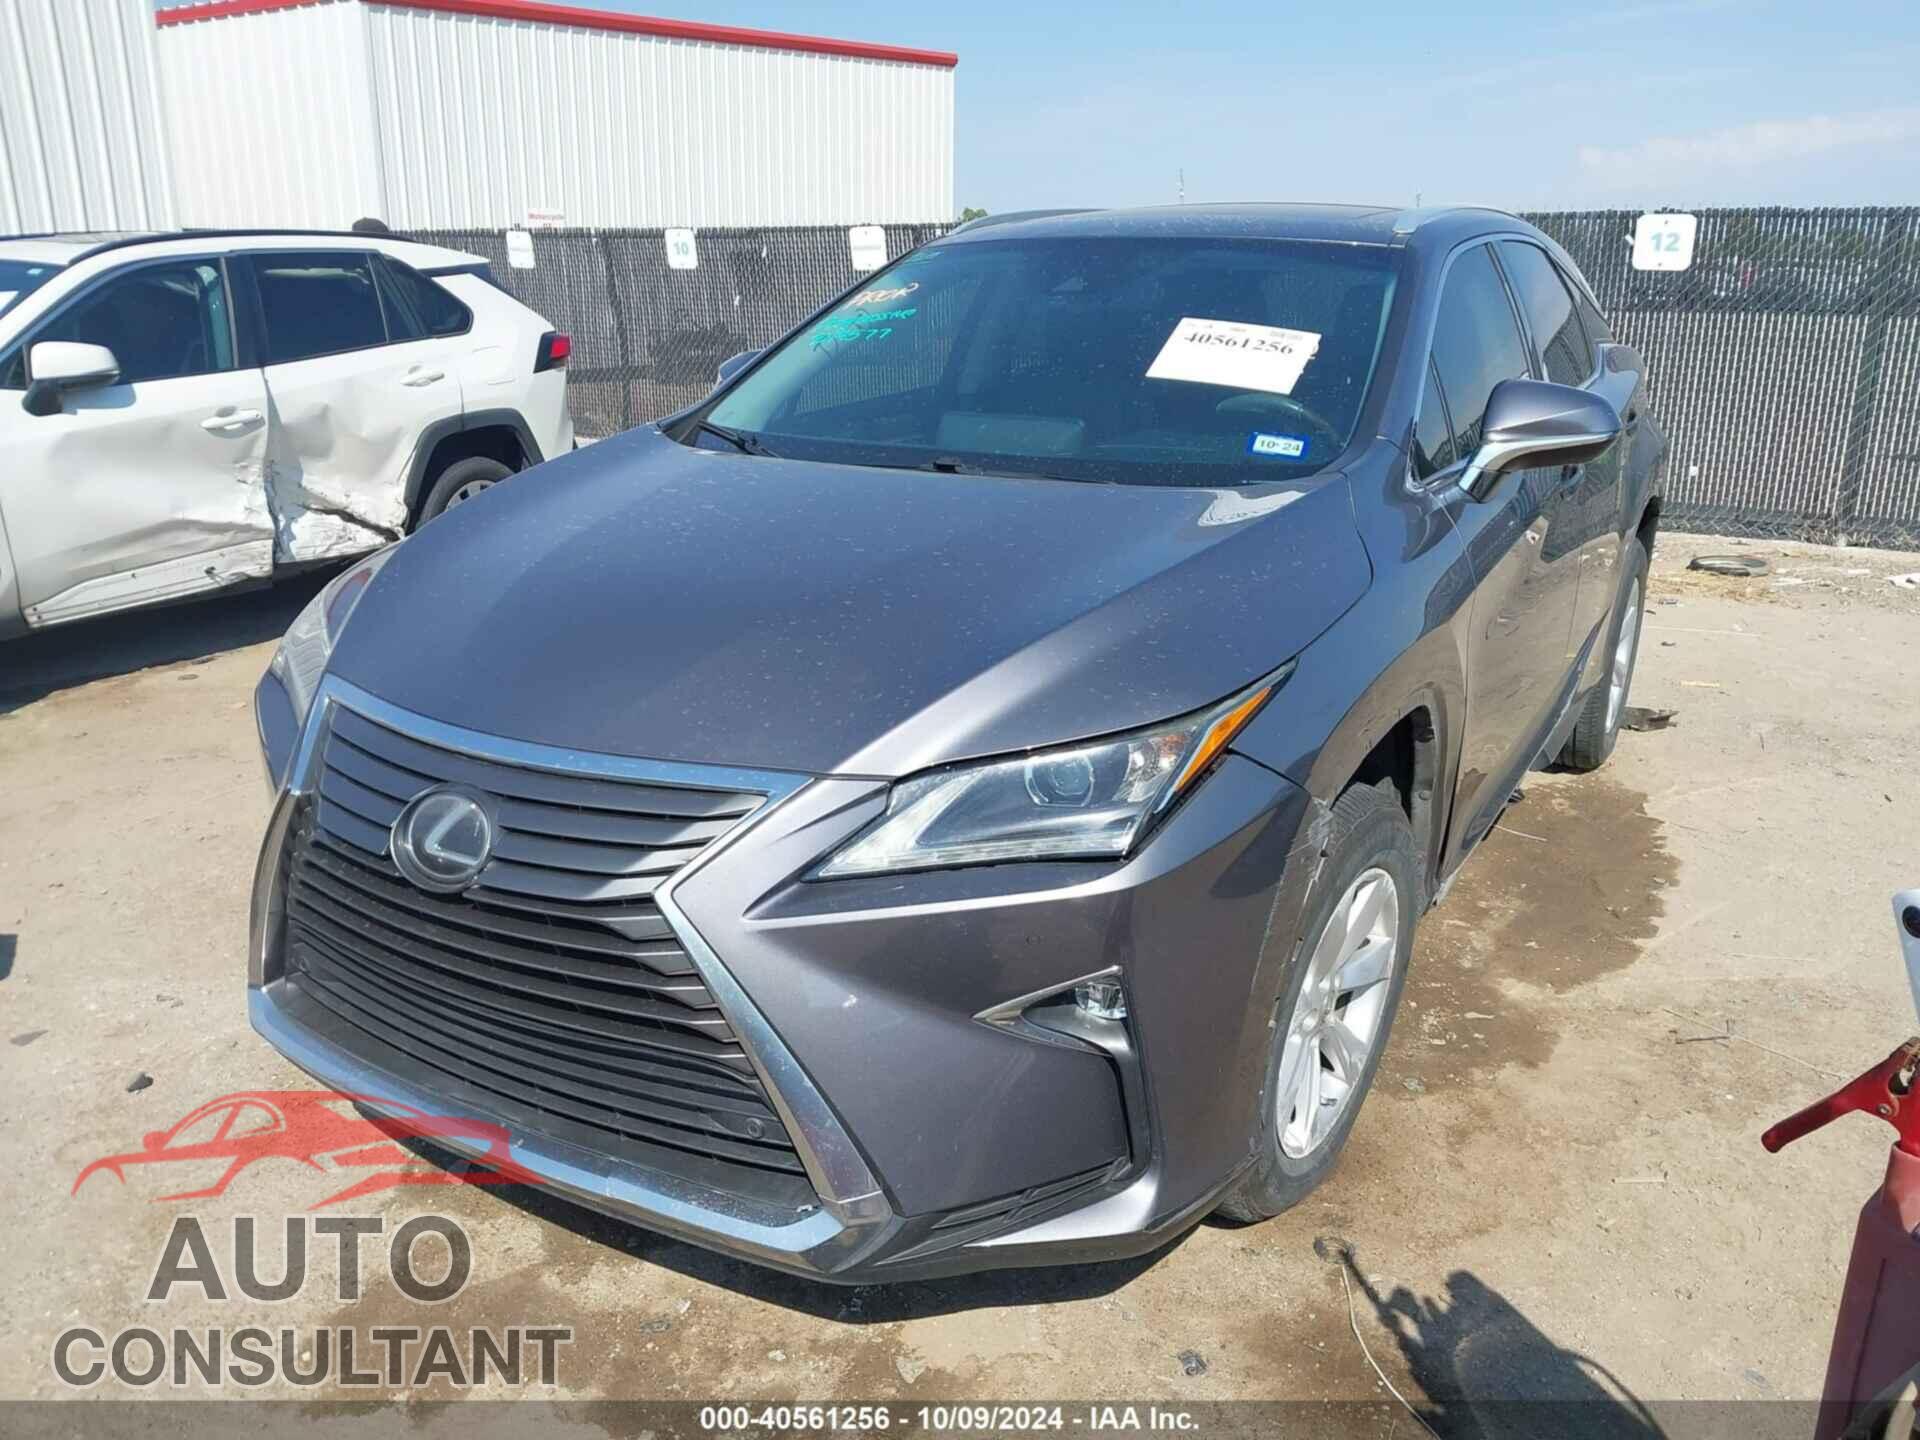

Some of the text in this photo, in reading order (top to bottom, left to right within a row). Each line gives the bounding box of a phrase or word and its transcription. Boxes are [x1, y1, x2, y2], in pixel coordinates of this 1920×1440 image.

[673, 241, 689, 256] 10
[1651, 232, 1680, 252] 12
[1184, 332, 1293, 355] 40561256
